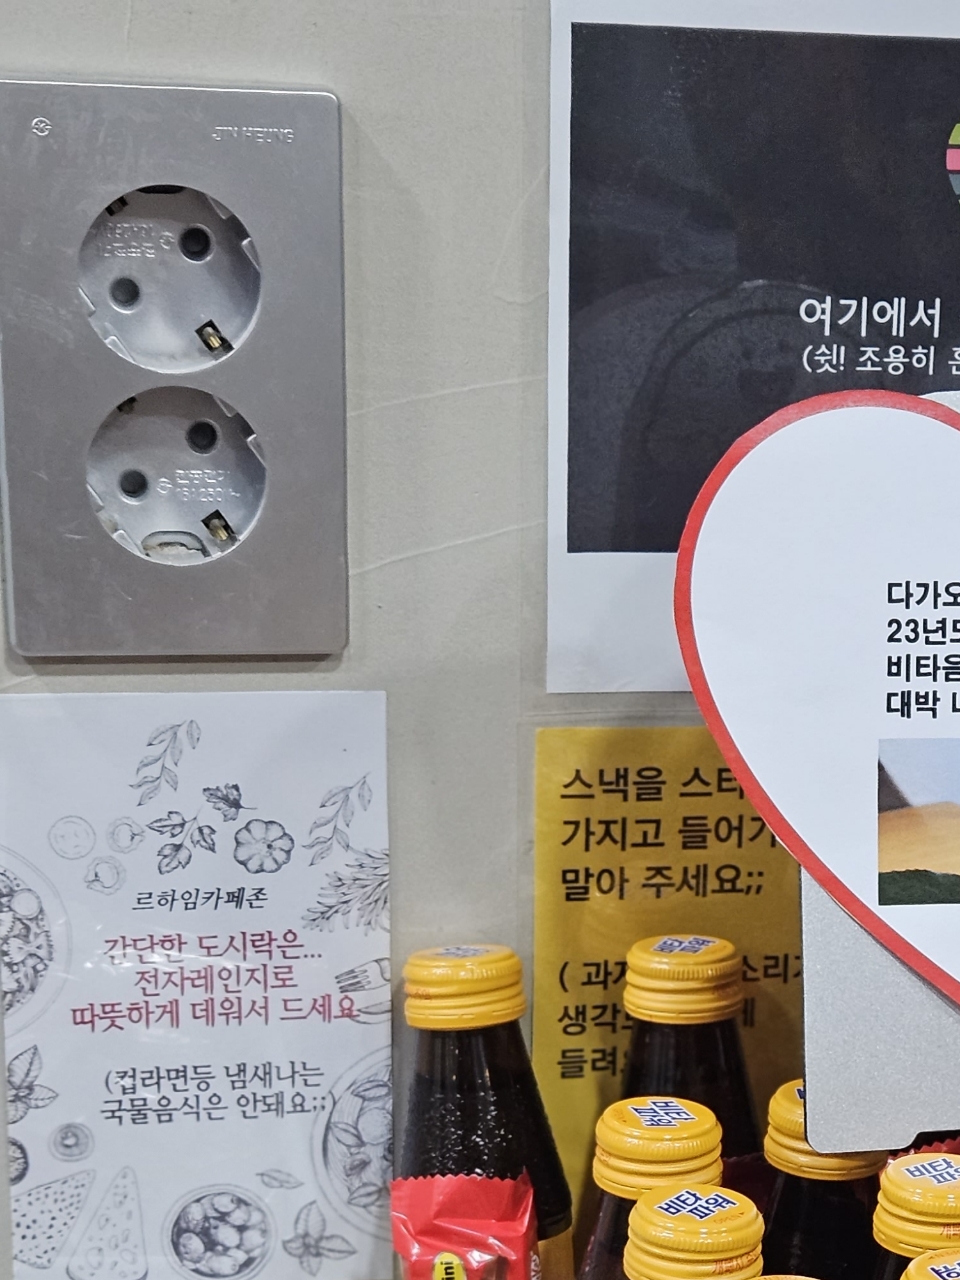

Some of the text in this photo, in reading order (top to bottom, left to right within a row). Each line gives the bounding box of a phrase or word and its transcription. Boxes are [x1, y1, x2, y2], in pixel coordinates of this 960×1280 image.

[799, 295, 942, 339] 여기에서
[802, 344, 846, 374] (쉿!
[855, 345, 935, 375] 조용히
[886, 690, 941, 719] 대박
[560, 766, 667, 802] 스낵을
[561, 817, 665, 851] 가지고
[132, 887, 268, 912] 르하임카페존
[562, 867, 629, 902] 말아
[103, 933, 187, 965] 간단한
[134, 964, 298, 998] 전자레인지로
[71, 993, 359, 1032] 따뜻하게 데워서 드세요
[105, 1060, 325, 1095] (컵라면등 냄새나는
[557, 1047, 628, 1079] 들려
[100, 1092, 229, 1126] 국물음식은
[904, 1158, 954, 1179] 비타
[655, 1190, 700, 1215] 비타
[687, 1193, 737, 1219] 파워
